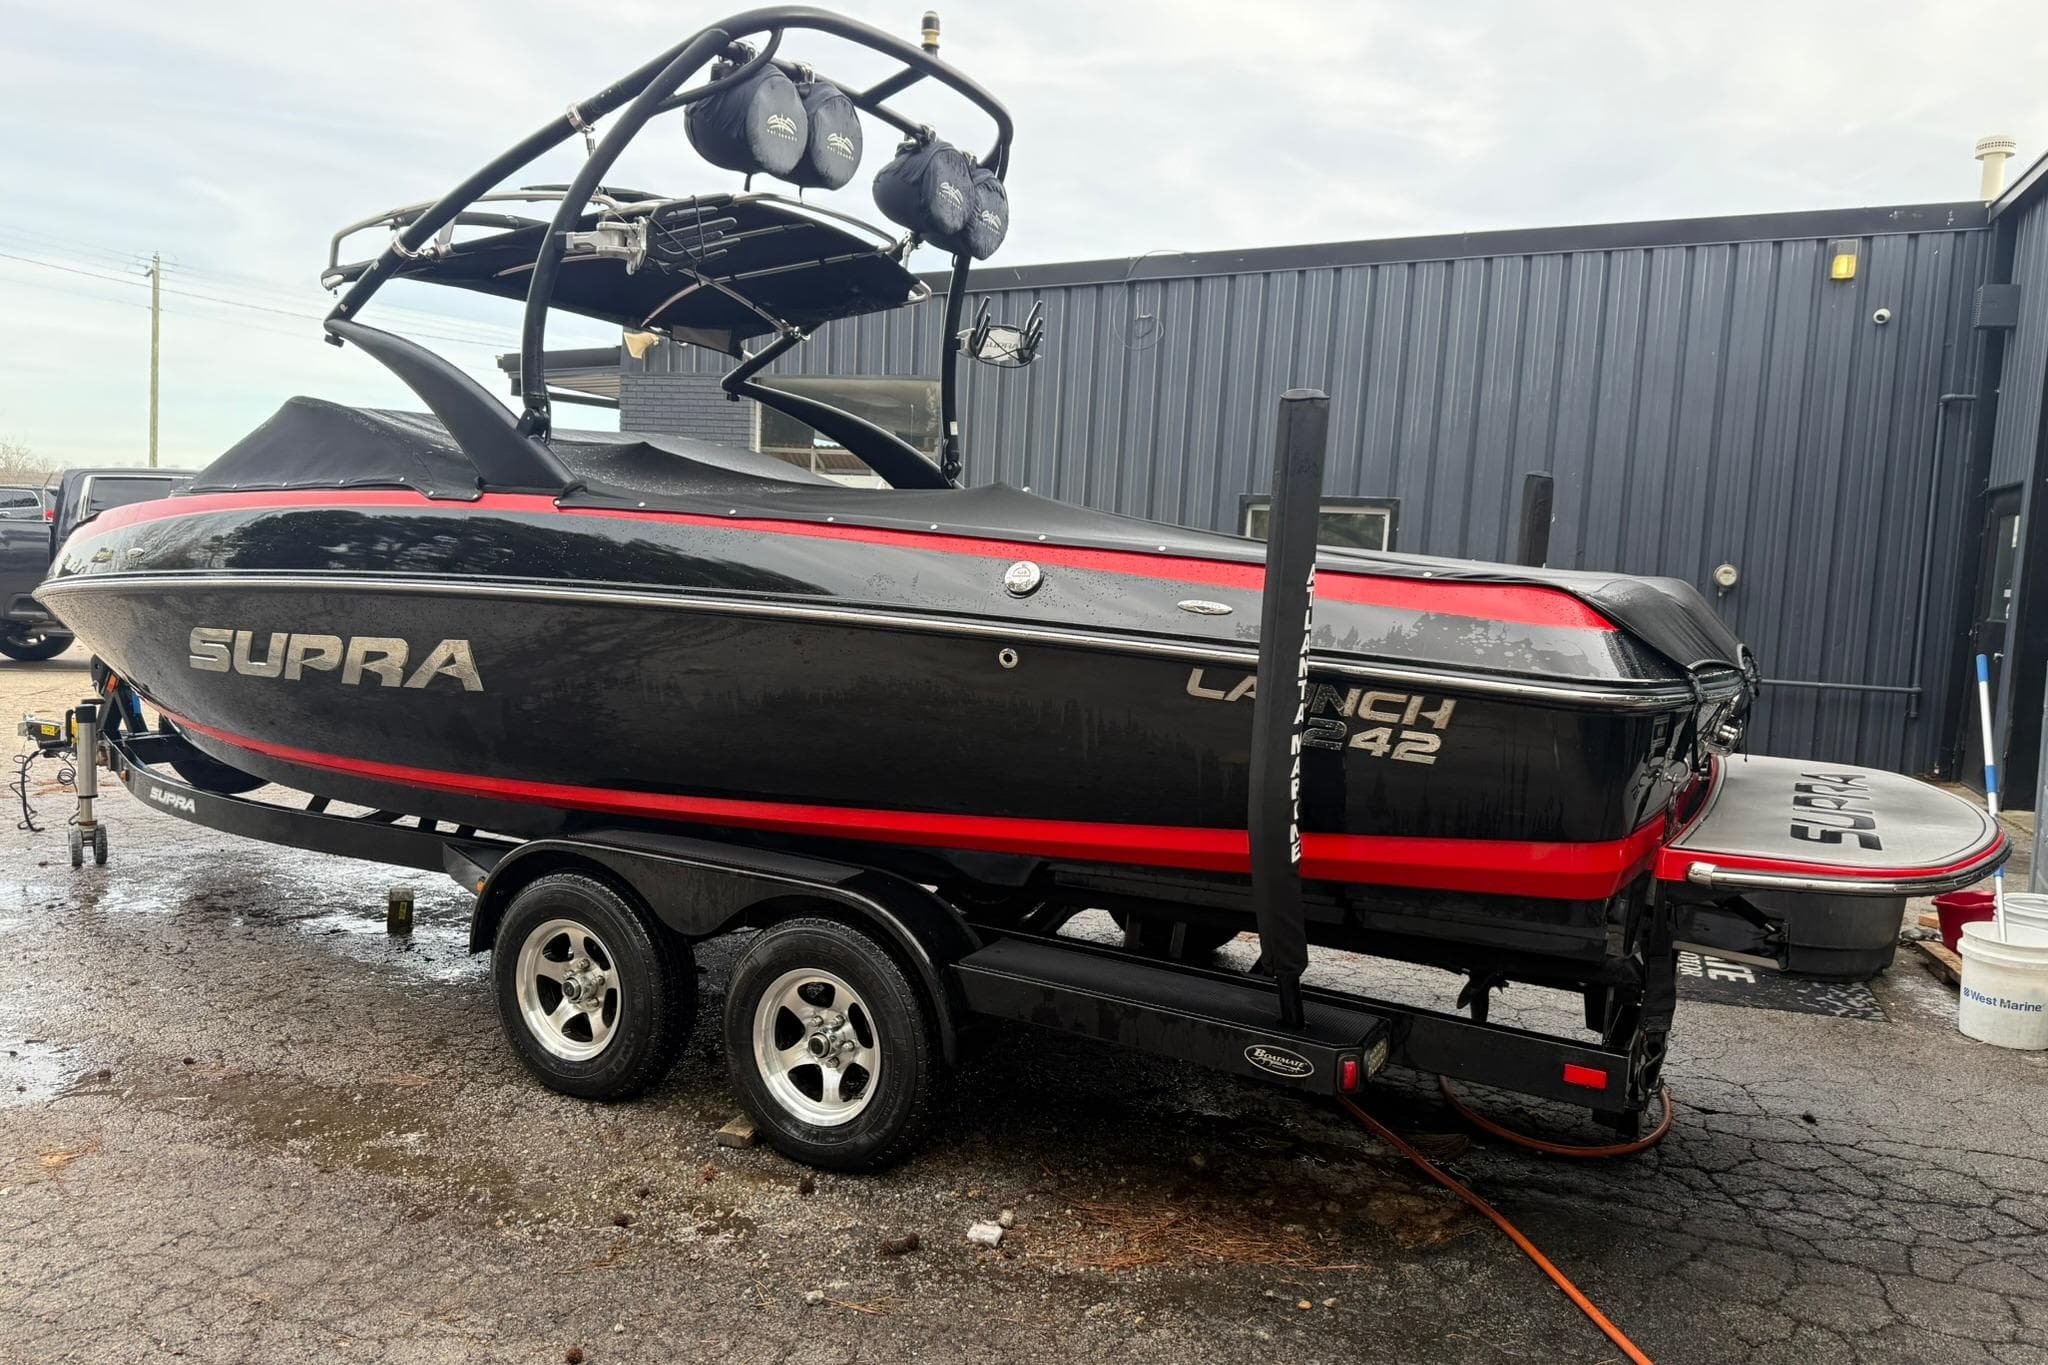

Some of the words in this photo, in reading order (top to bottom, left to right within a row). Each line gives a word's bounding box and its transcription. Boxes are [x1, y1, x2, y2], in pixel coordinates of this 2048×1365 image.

[189, 626, 484, 692] SUPRA
[1293, 563, 1316, 725] ATLANTA
[1186, 668, 1457, 730] LANCH
[1302, 717, 1442, 765] 242
[149, 786, 196, 814] SUPRA
[1290, 732, 1302, 864] MARINE
[1790, 773, 1882, 851] SUPRA
[1970, 989, 1997, 1007] West
[1999, 998, 2043, 1013] Marine
